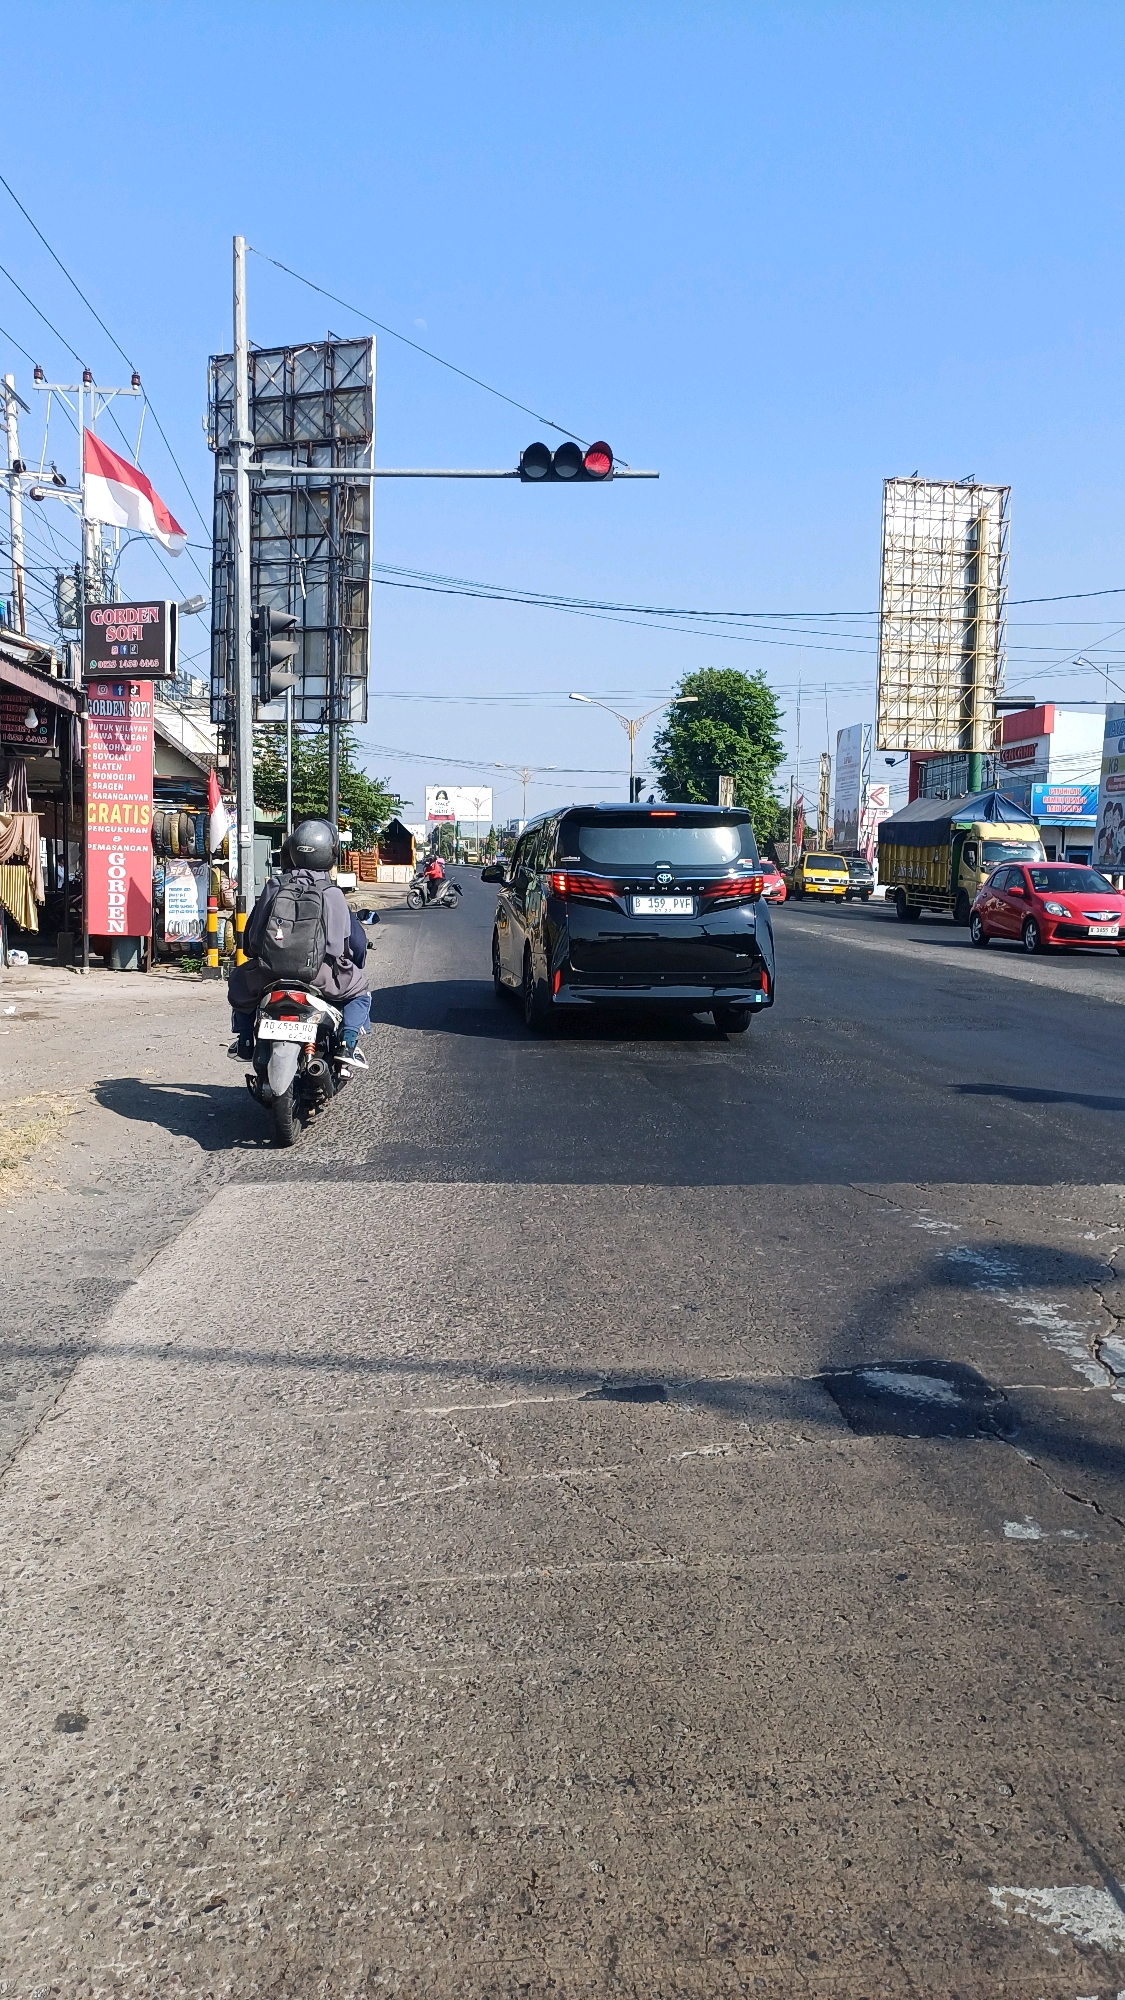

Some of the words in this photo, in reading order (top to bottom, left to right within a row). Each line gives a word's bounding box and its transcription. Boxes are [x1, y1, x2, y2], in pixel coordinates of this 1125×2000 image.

[90, 606, 160, 625] GORDEN
[105, 624, 143, 642] SOFI
[88, 699, 126, 717] GORDEN
[128, 701, 151, 718] SOFI
[88, 723, 114, 732] UNTUK
[115, 724, 148, 733] WILAYAH
[88, 732, 113, 741] JAWA
[114, 732, 148, 742] TENGAH
[92, 743, 142, 752] SUKOHARJO
[92, 752, 132, 762] BOYOLALI
[92, 762, 122, 771] KLATEN
[1108, 758, 1119, 774] KB
[92, 772, 136, 781] WONOGIRI
[92, 781, 124, 791] SRAGEN
[92, 791, 148, 801] KARANGANYAR
[88, 802, 150, 825] GRATIS
[88, 825, 148, 834] PENGUKURAN
[88, 844, 149, 852] PEMASANGAN
[107, 852, 126, 933] GORDEN
[635, 898, 641, 908] B
[648, 898, 666, 908] 159
